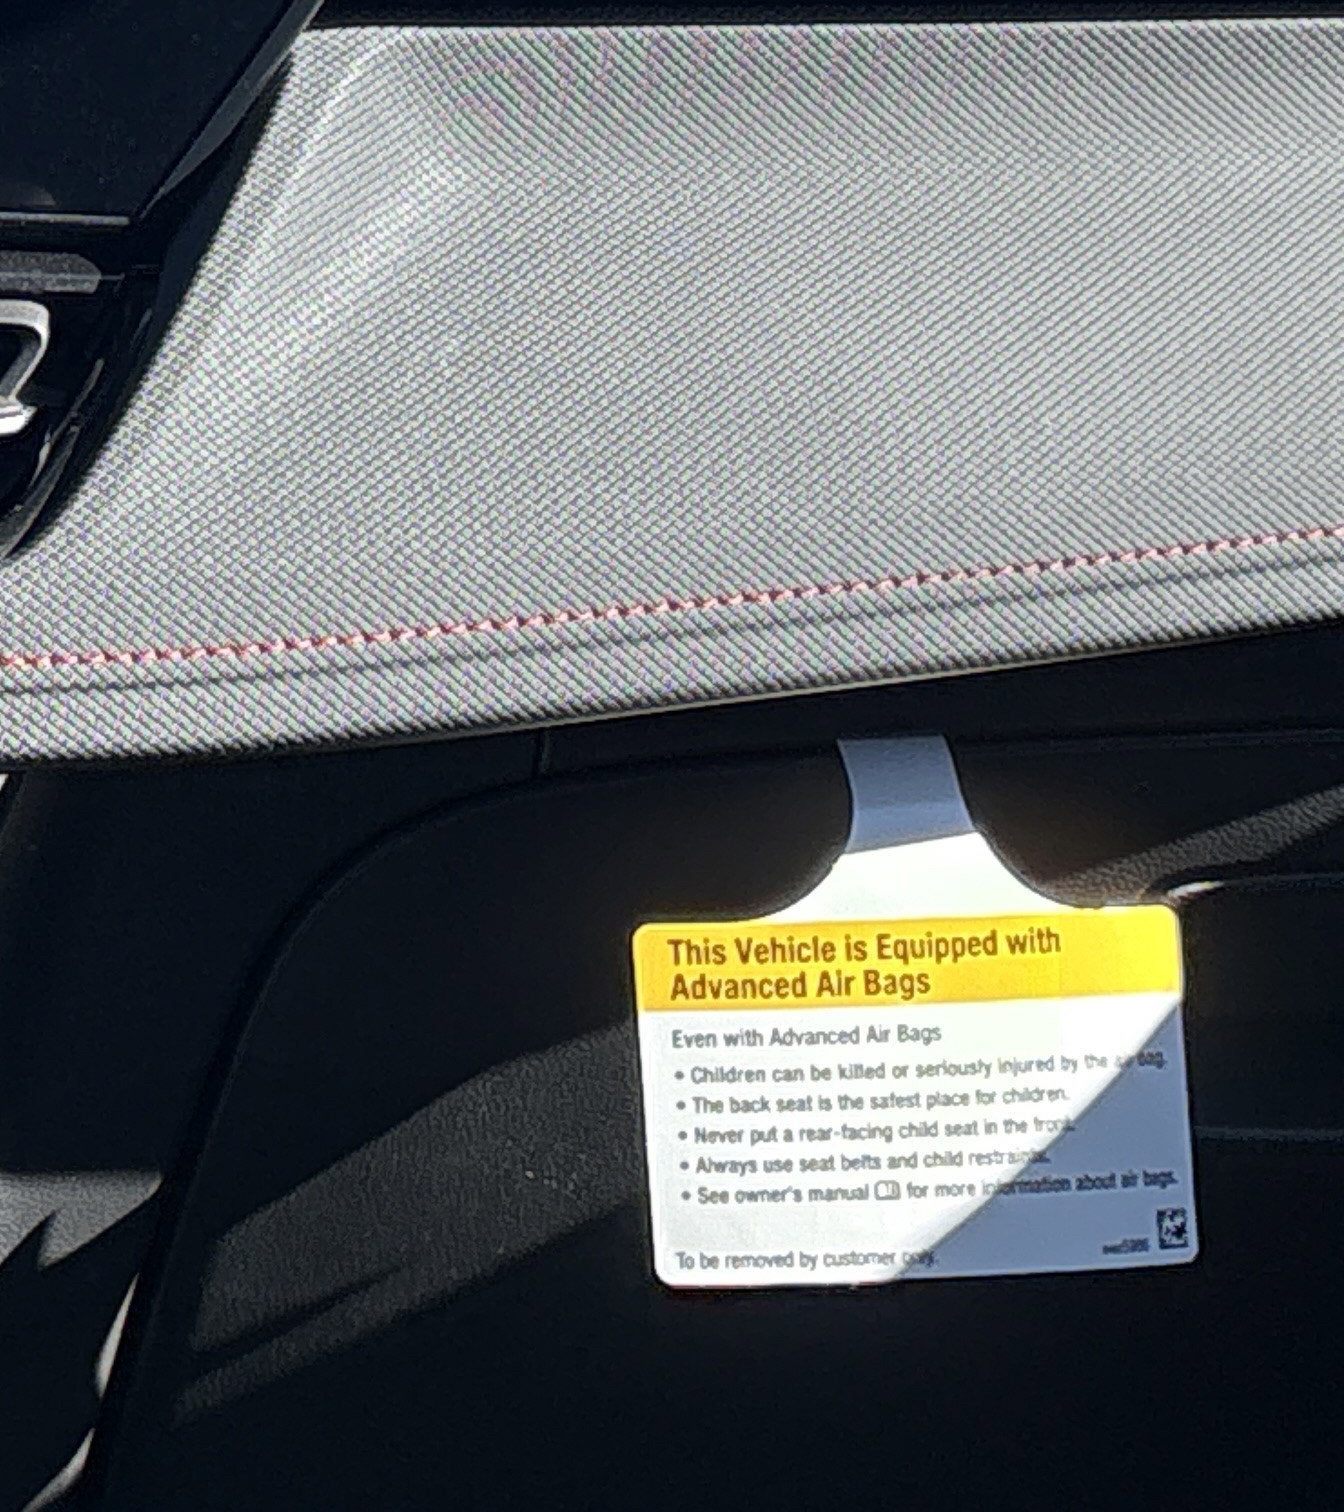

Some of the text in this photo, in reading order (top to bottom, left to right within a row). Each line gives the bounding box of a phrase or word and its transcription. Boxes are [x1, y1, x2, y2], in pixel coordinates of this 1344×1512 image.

[667, 926, 1062, 966] This Vehicle is Equipped with
[670, 969, 931, 1001] Advanced Air Bags
[672, 1023, 942, 1048] Even with Advanced Air Bags
[690, 1065, 766, 1084] Children
[772, 1067, 805, 1083] can
[810, 1064, 832, 1081] be
[837, 1062, 886, 1080] killed
[892, 1065, 910, 1079] or
[915, 1059, 991, 1078] seriously
[997, 1054, 1055, 1077] injured
[1060, 1054, 1078, 1074] by
[1084, 1053, 1108, 1068] the
[692, 1096, 724, 1114] The
[729, 1095, 771, 1113] back
[776, 1095, 813, 1113] seat
[818, 1095, 833, 1111] is
[837, 1093, 864, 1110] the
[870, 1092, 921, 1110] safest
[926, 1091, 970, 1110] place
[975, 1089, 997, 1105] for
[694, 1126, 744, 1143] Never
[750, 1126, 778, 1146] put
[783, 1128, 794, 1142] a
[799, 1122, 894, 1143] rear-facing
[898, 1121, 938, 1138] child
[944, 1120, 979, 1137] seat
[984, 1119, 998, 1134] in
[1003, 1119, 1028, 1134] the
[696, 1156, 758, 1177] Always
[763, 1159, 793, 1173] use
[799, 1155, 836, 1172] seat
[841, 1153, 881, 1170] belts
[887, 1151, 918, 1169] and
[923, 1151, 963, 1168] child
[697, 1187, 730, 1204] See
[735, 1185, 803, 1204] owner's
[808, 1184, 869, 1201] manual
[907, 1182, 928, 1198] for
[935, 1183, 976, 1197] more
[675, 1251, 694, 1270] To
[700, 1251, 719, 1269] be
[725, 1250, 794, 1269] removed
[799, 1250, 818, 1271] by
[823, 1249, 896, 1267] customer
